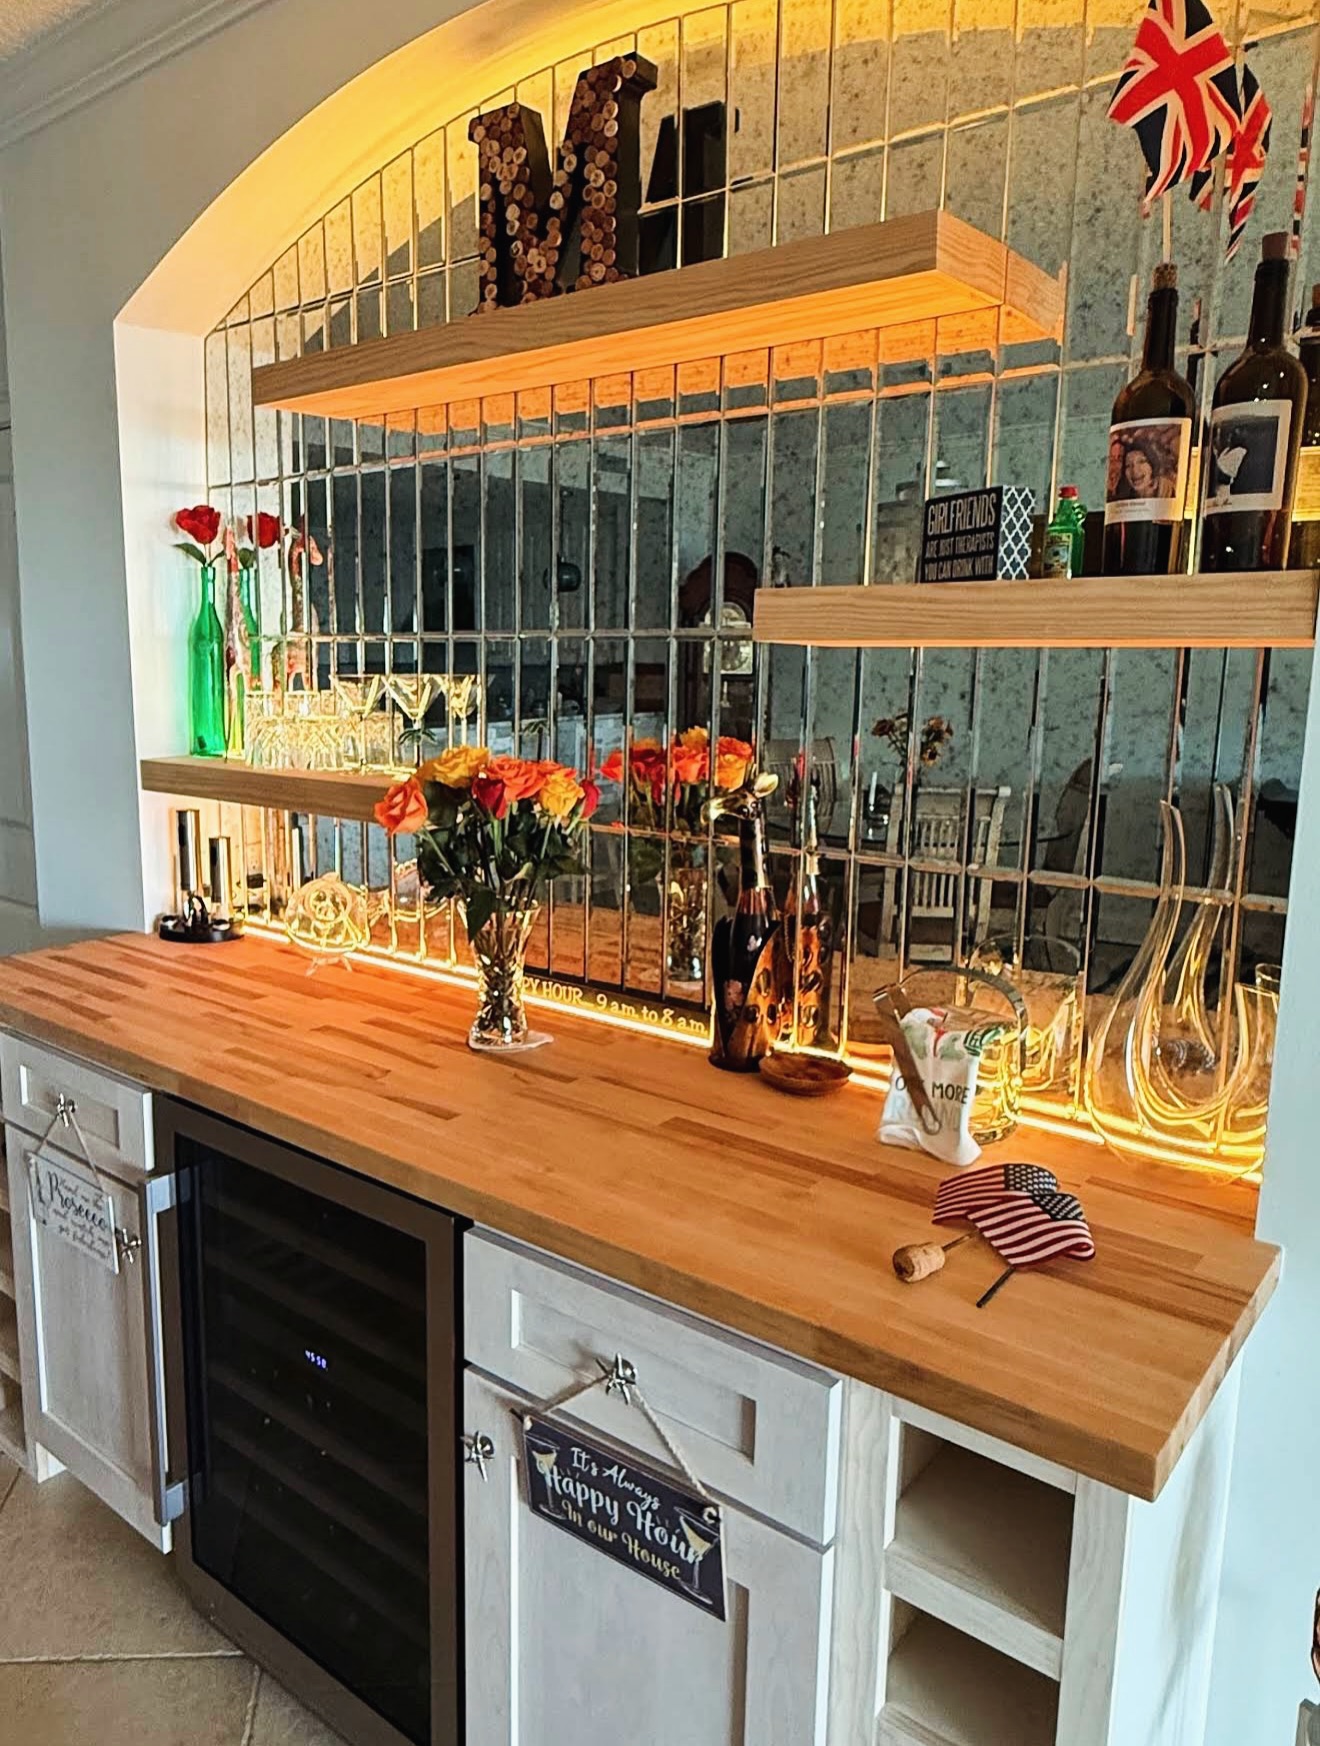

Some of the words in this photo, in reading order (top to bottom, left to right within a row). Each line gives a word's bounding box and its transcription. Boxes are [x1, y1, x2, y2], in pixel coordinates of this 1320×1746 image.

[468, 51, 657, 316] M
[927, 493, 996, 535] GIRLFRIENDS
[925, 541, 937, 559] ARE
[939, 538, 954, 556] JUST
[956, 532, 994, 554] THERAPISTS
[925, 563, 937, 580] YOU
[938, 561, 951, 579] CAN
[953, 558, 974, 577] DRINK
[975, 556, 993, 575] WITH
[596, 993, 608, 1011] 9
[641, 1005, 659, 1023] to
[661, 1007, 675, 1027] 8
[931, 1081, 971, 1105] MORE
[602, 1464, 661, 1511] Always
[536, 1459, 620, 1526] Happy
[626, 1500, 703, 1564] Hour
[561, 1498, 583, 1528] In
[586, 1519, 618, 1543] our
[621, 1531, 682, 1581] House
